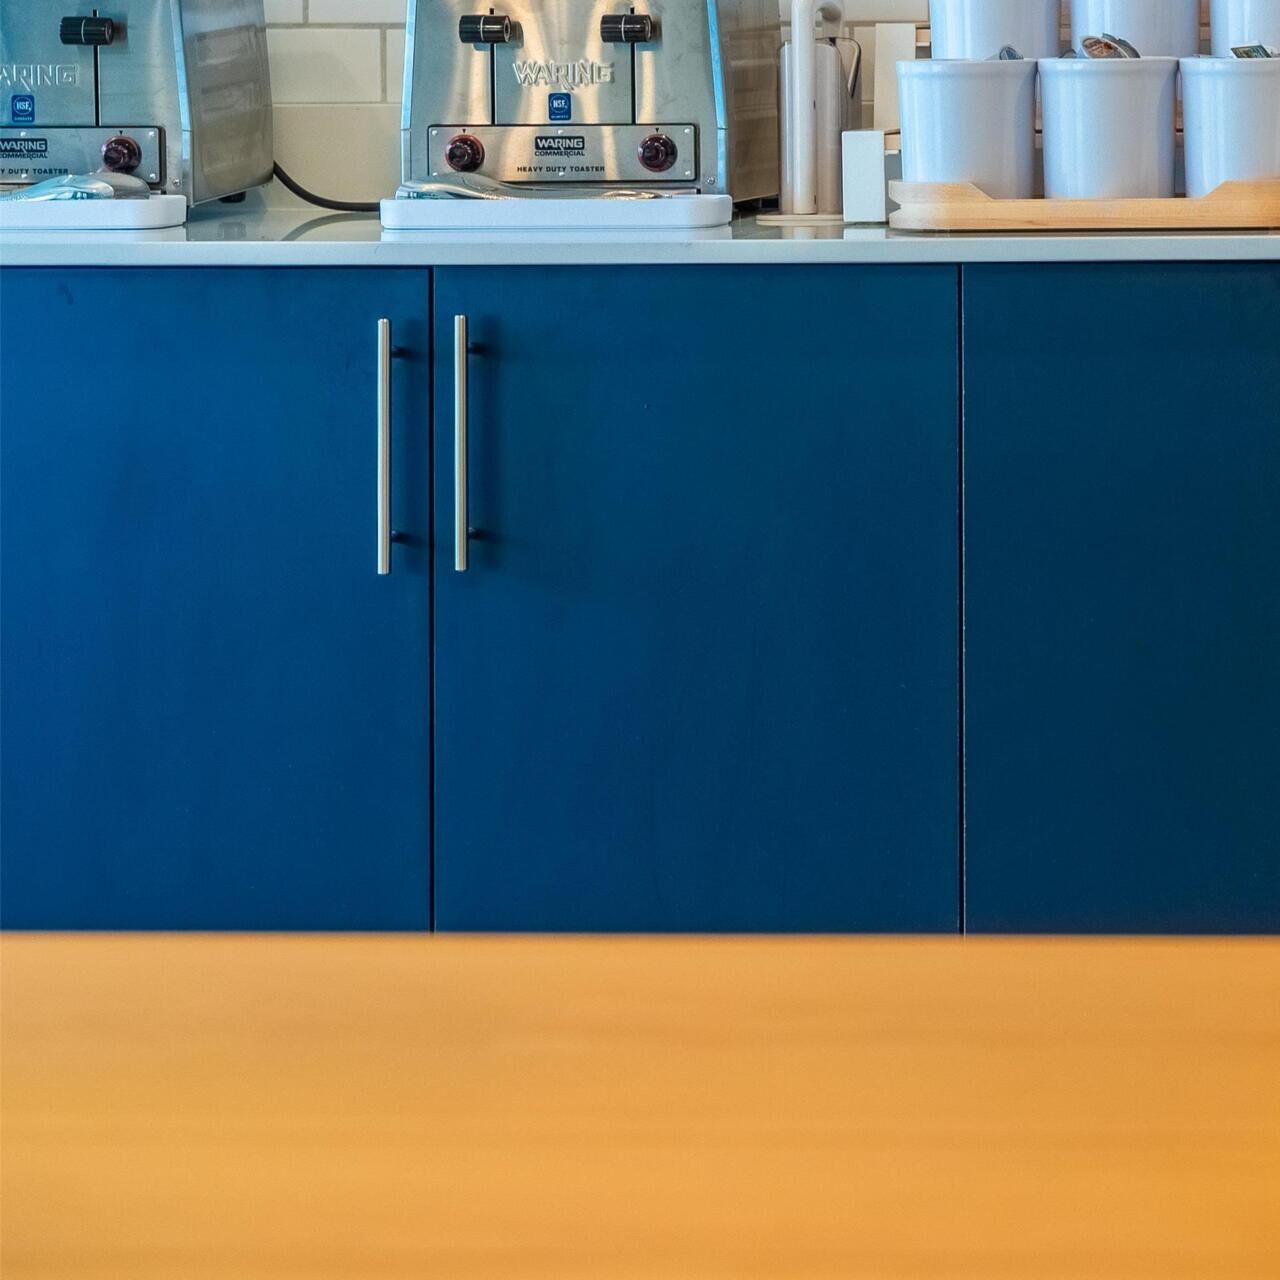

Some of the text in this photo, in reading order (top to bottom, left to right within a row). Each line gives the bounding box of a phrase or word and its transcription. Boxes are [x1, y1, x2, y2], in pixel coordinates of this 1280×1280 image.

[512, 61, 615, 91] WARING
[537, 138, 583, 151] WARING
[0, 152, 48, 160] OMMERCIAL
[535, 150, 585, 158] COMMERCIAL
